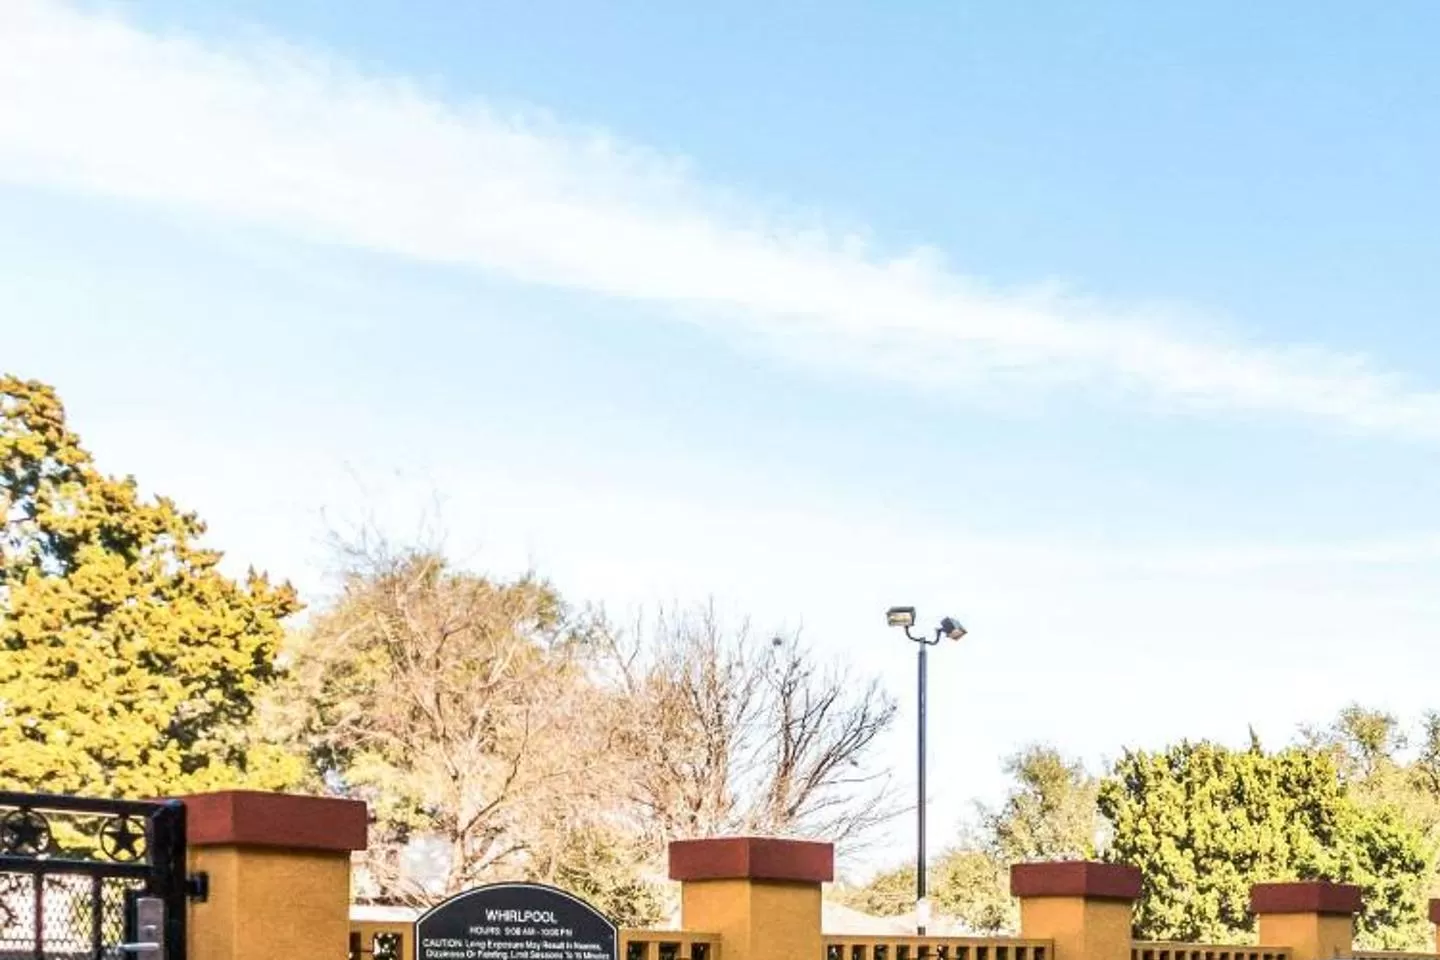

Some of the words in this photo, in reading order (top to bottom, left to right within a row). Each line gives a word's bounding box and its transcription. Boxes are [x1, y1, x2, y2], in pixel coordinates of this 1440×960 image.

[485, 910, 557, 923] WHIRLPOOL
[488, 940, 524, 950] Exposure
[526, 941, 541, 950] May
[543, 941, 564, 949] Result
[466, 950, 476, 958] Or
